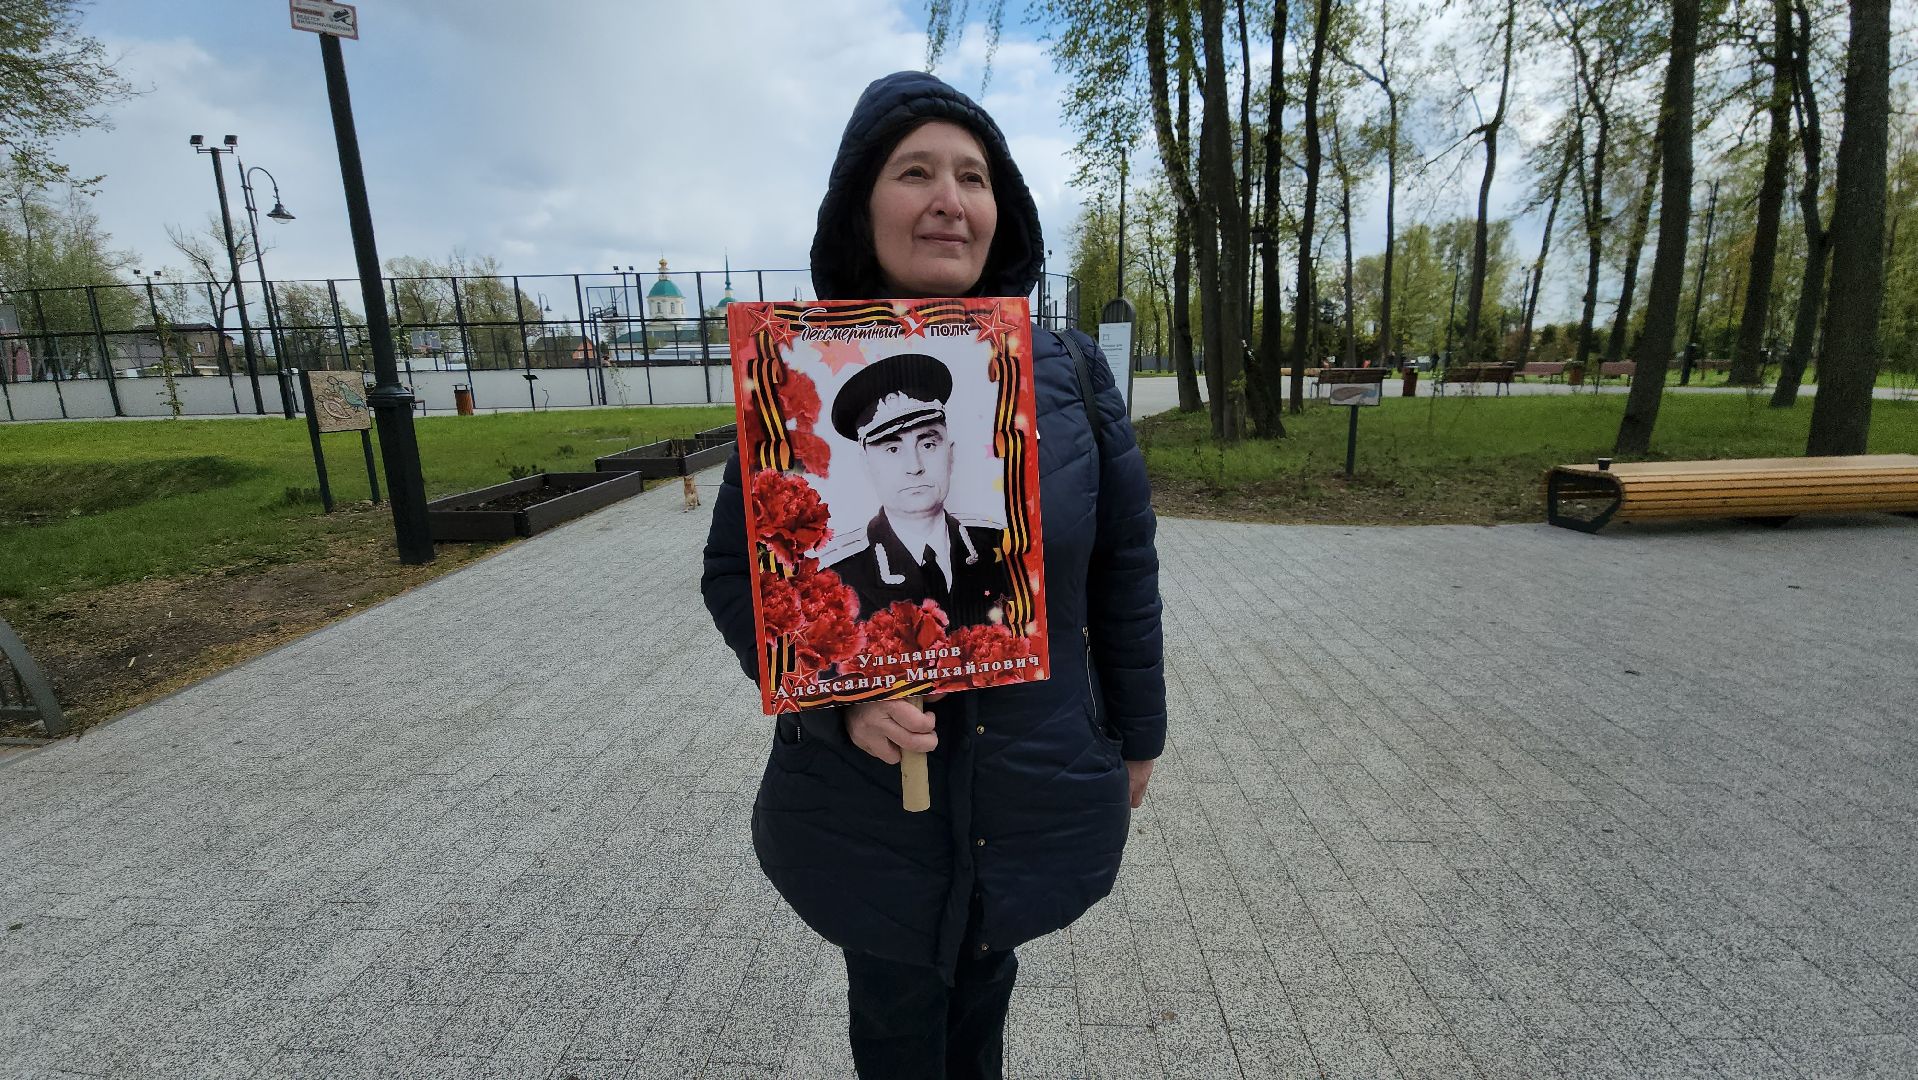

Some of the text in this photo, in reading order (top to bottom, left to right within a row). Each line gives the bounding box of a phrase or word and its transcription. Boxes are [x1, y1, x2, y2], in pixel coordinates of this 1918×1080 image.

[799, 308, 902, 344] Бессмертный
[857, 645, 962, 668] Ульданов
[774, 655, 1041, 700] Александр Михайлович
